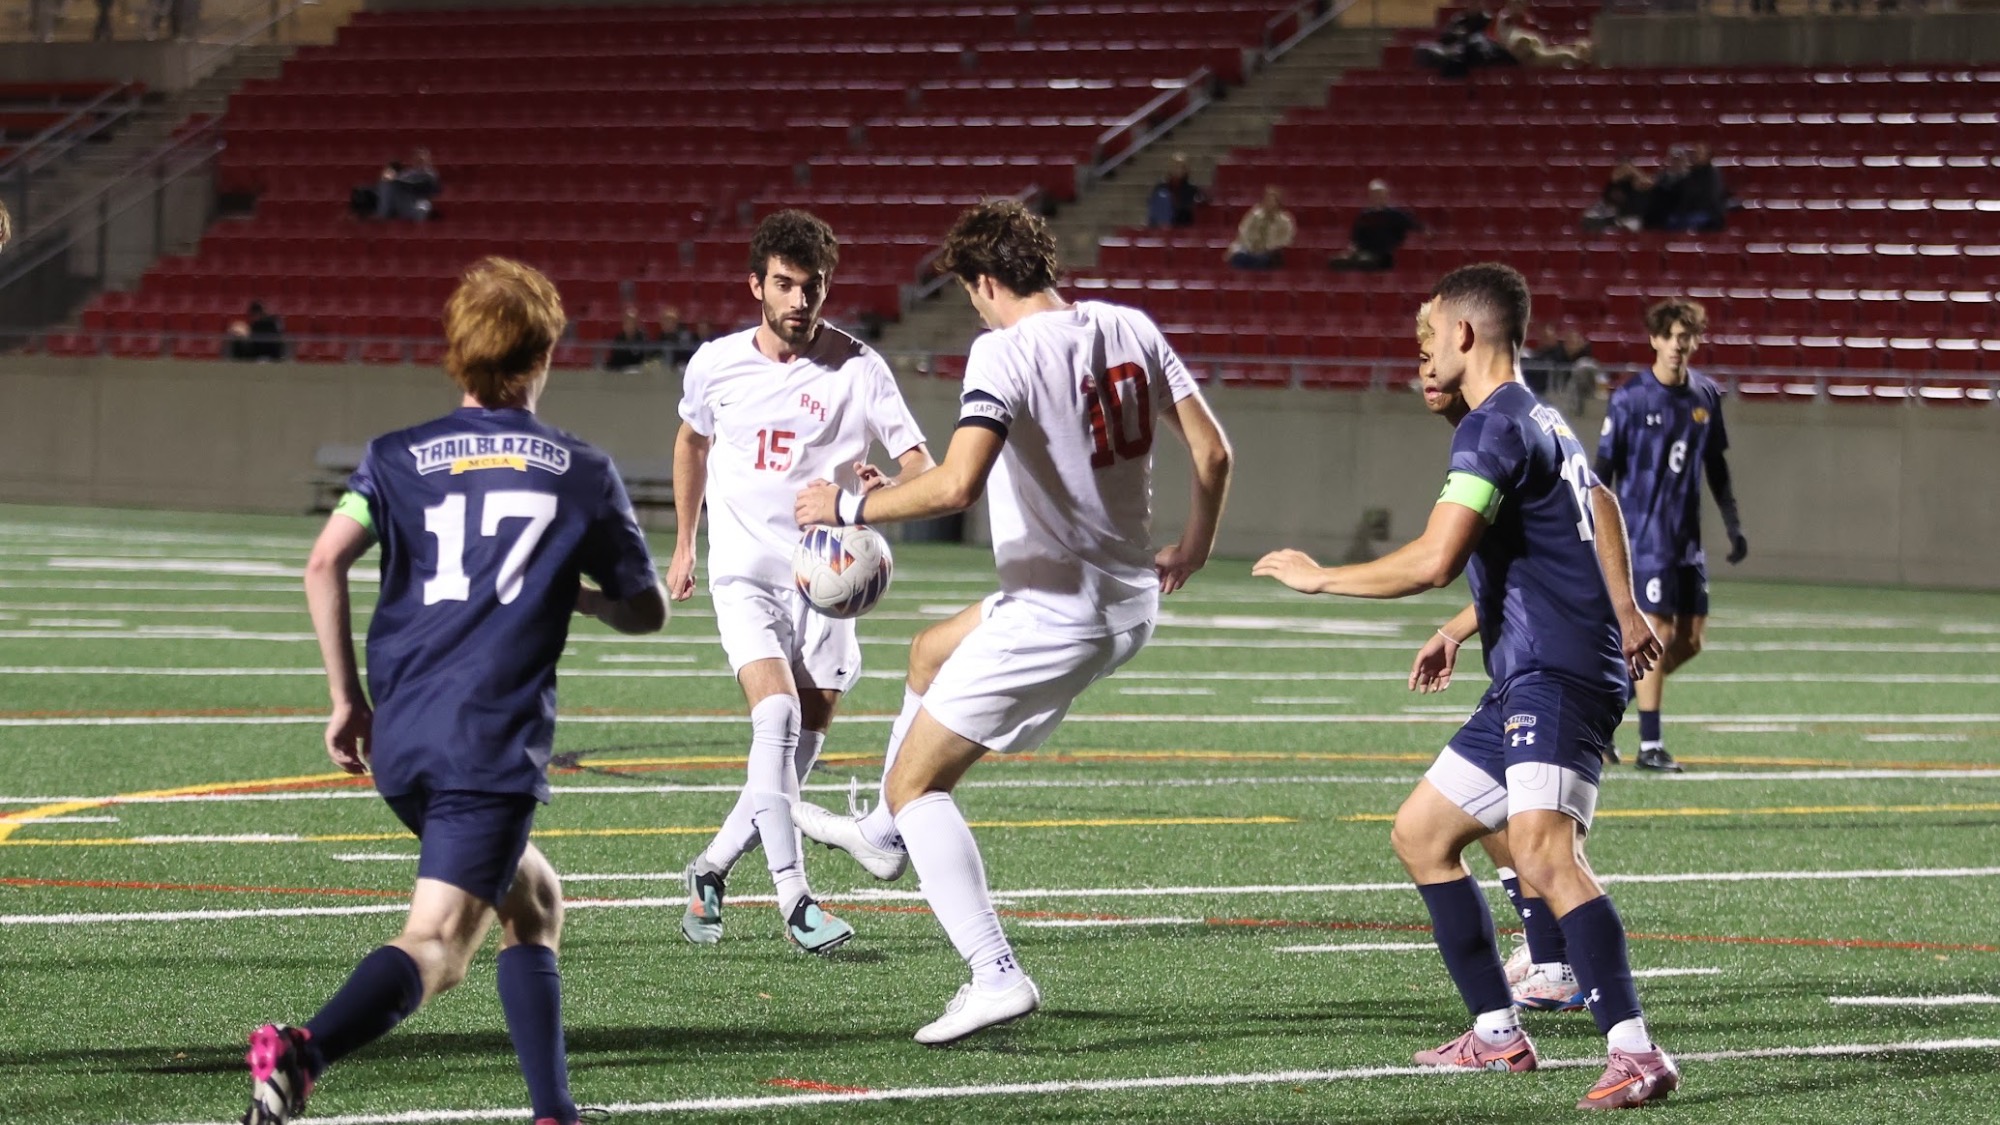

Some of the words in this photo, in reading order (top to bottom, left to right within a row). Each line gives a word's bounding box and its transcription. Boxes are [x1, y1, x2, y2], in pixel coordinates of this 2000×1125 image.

[800, 393, 827, 422] RPI
[1080, 361, 1150, 470] 10
[418, 437, 567, 467] TRAILBLAZERS
[467, 458, 510, 468] MCLA
[755, 429, 796, 472] 15
[1668, 440, 1688, 474] 6
[423, 490, 558, 606] 17
[1646, 577, 1662, 604] 6
